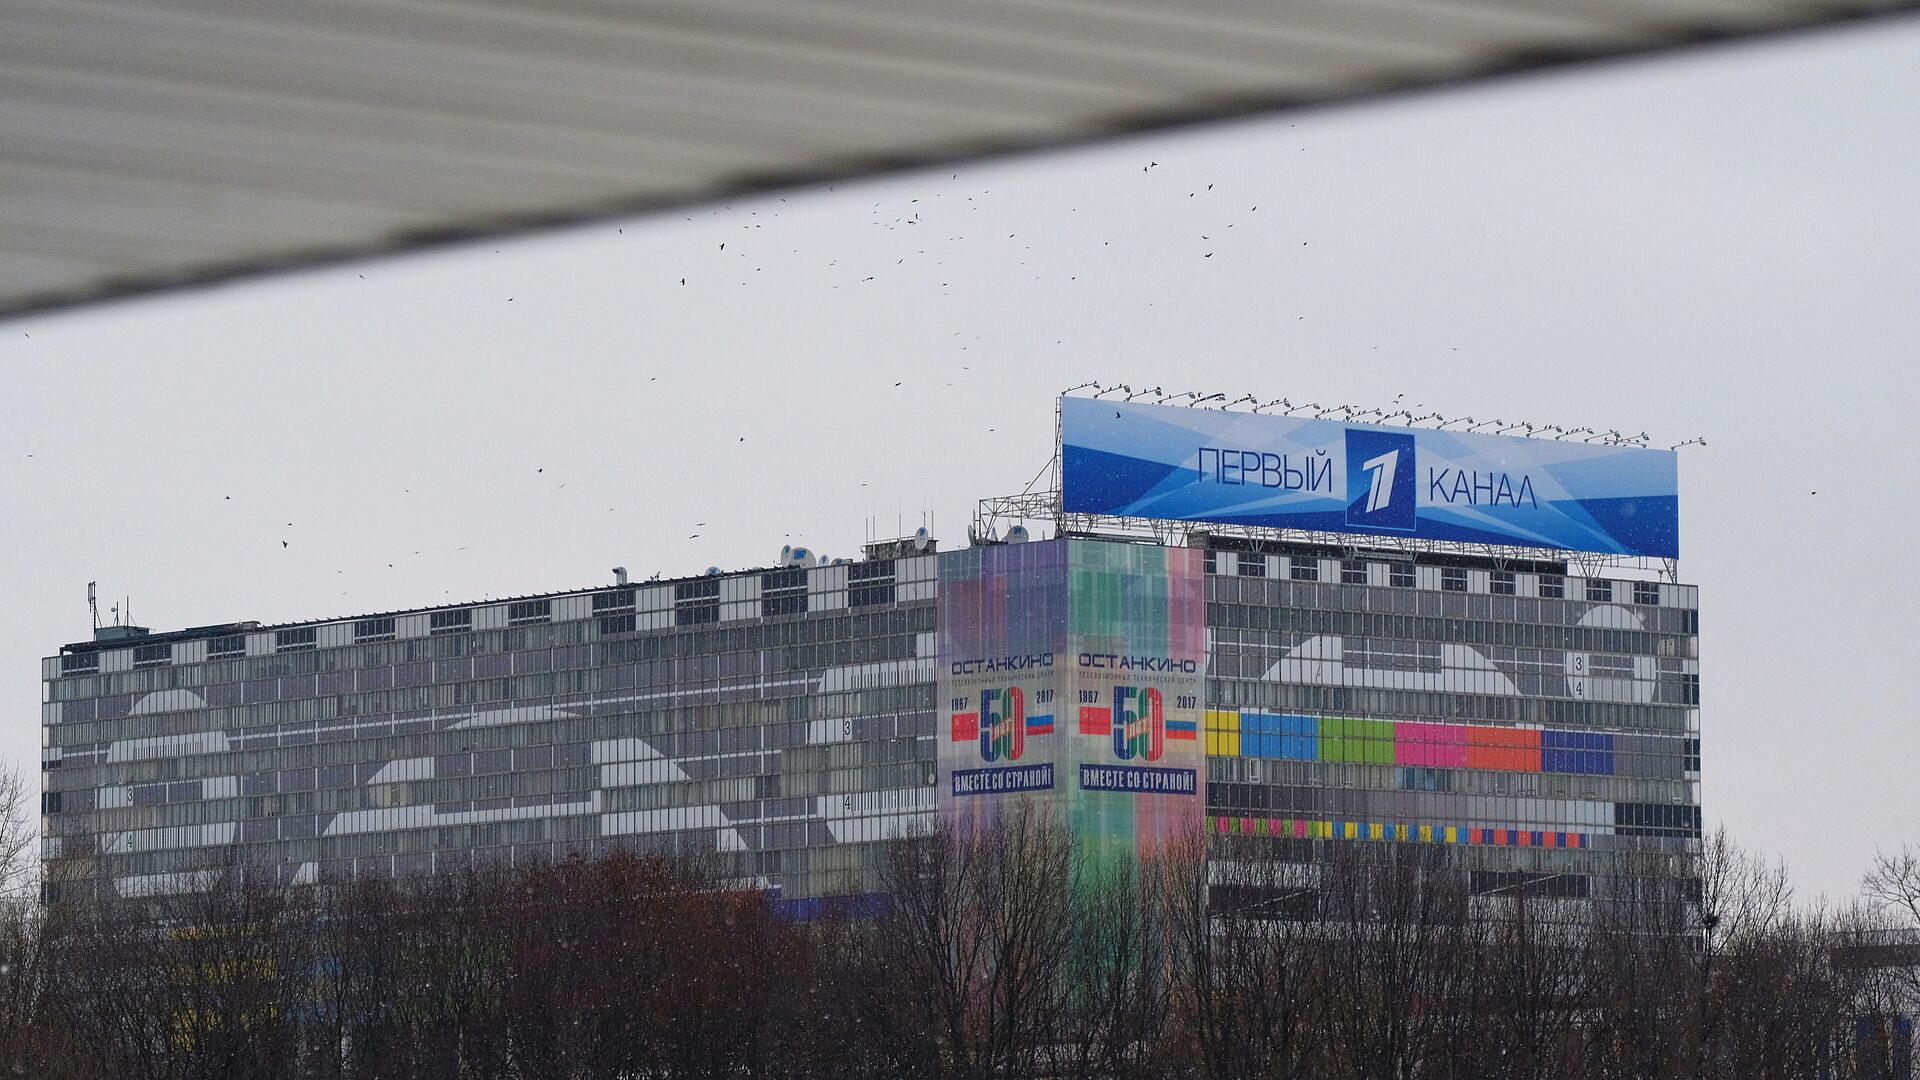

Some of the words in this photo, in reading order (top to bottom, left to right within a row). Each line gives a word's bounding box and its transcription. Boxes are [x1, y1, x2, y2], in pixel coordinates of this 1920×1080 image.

[1198, 448, 1332, 493] ПЕРВЫЙ
[1362, 448, 1399, 514] 1
[1429, 466, 1538, 510] КАНАЛ
[951, 653, 1054, 675] ОСТАНКИНО
[1079, 653, 1196, 674] ОСТАНКИНО
[1575, 656, 1582, 672] 3
[1575, 681, 1582, 695] 4
[951, 697, 968, 711] 1967
[1036, 689, 1054, 704] 2017
[1079, 690, 1098, 704] 1967
[1177, 696, 1197, 709] 2017
[844, 721, 851, 736] 3
[981, 687, 1025, 762] 50
[1114, 686, 1163, 762] 50
[955, 771, 991, 793] ВМЕСТЕ
[992, 771, 1004, 789] СО
[1006, 766, 1051, 788] СТРАНОЙ!
[1082, 769, 1124, 788] ВМЕСТЕ
[1127, 771, 1140, 787] СО
[1143, 771, 1193, 791] СТРАНОЙ!
[127, 788, 133, 802] 3
[844, 795, 851, 810] 4
